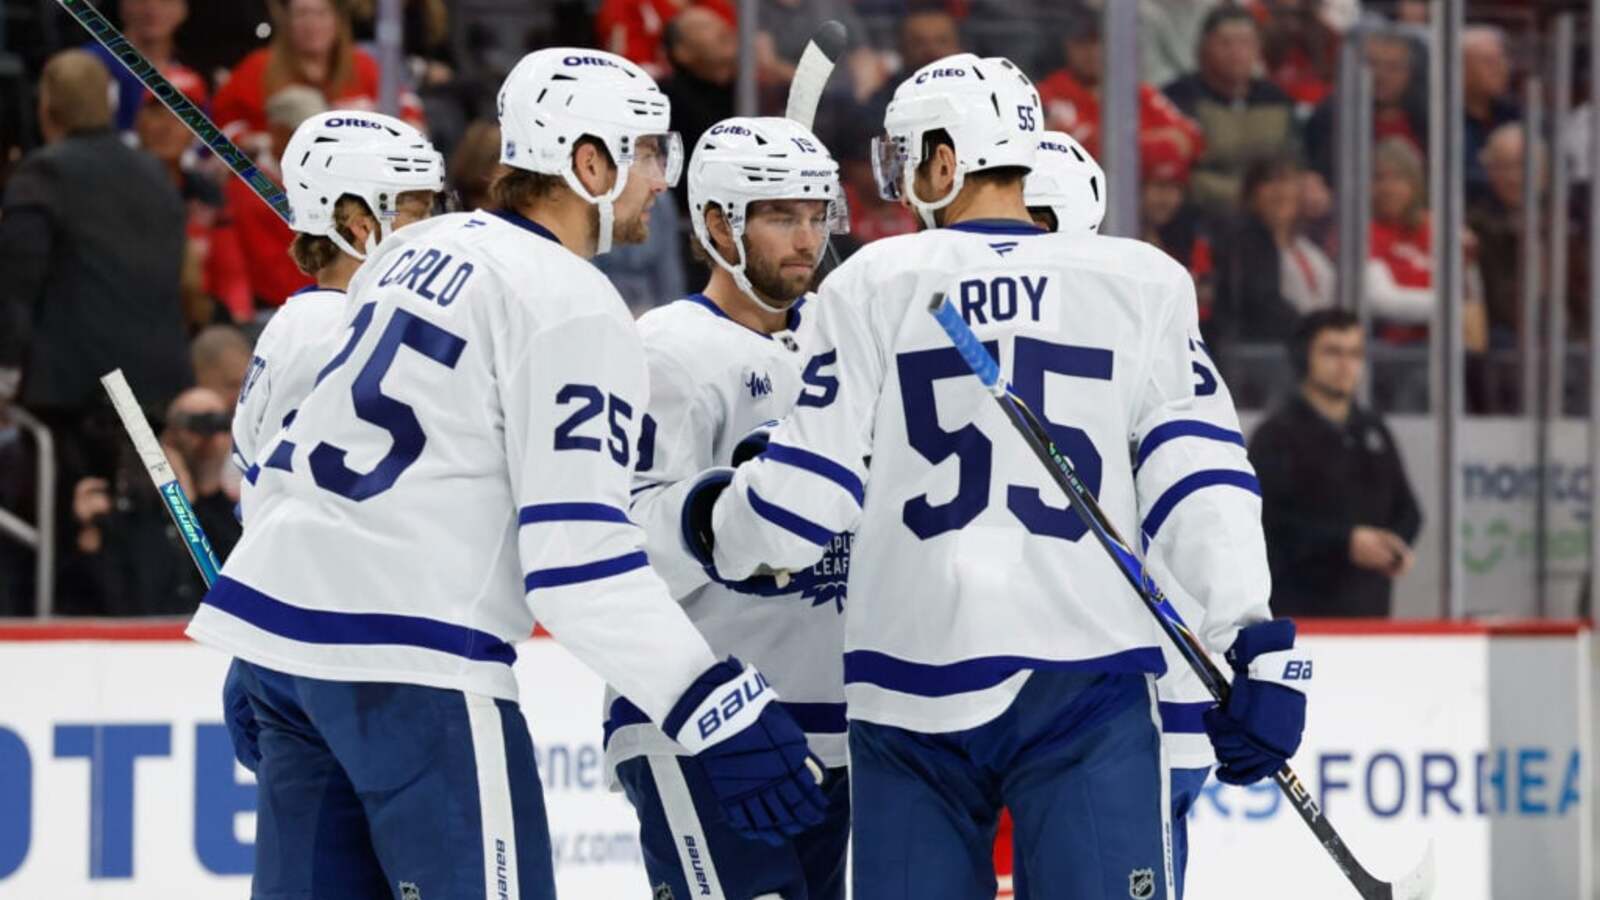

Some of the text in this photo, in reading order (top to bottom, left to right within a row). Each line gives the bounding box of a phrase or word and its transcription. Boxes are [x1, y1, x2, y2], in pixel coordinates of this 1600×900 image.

[324, 118, 382, 130] OREO
[1017, 105, 1035, 131] 55
[1037, 141, 1068, 153] REO
[960, 276, 1048, 327] ROY
[554, 383, 633, 469] 25
[896, 335, 1114, 542] 55
